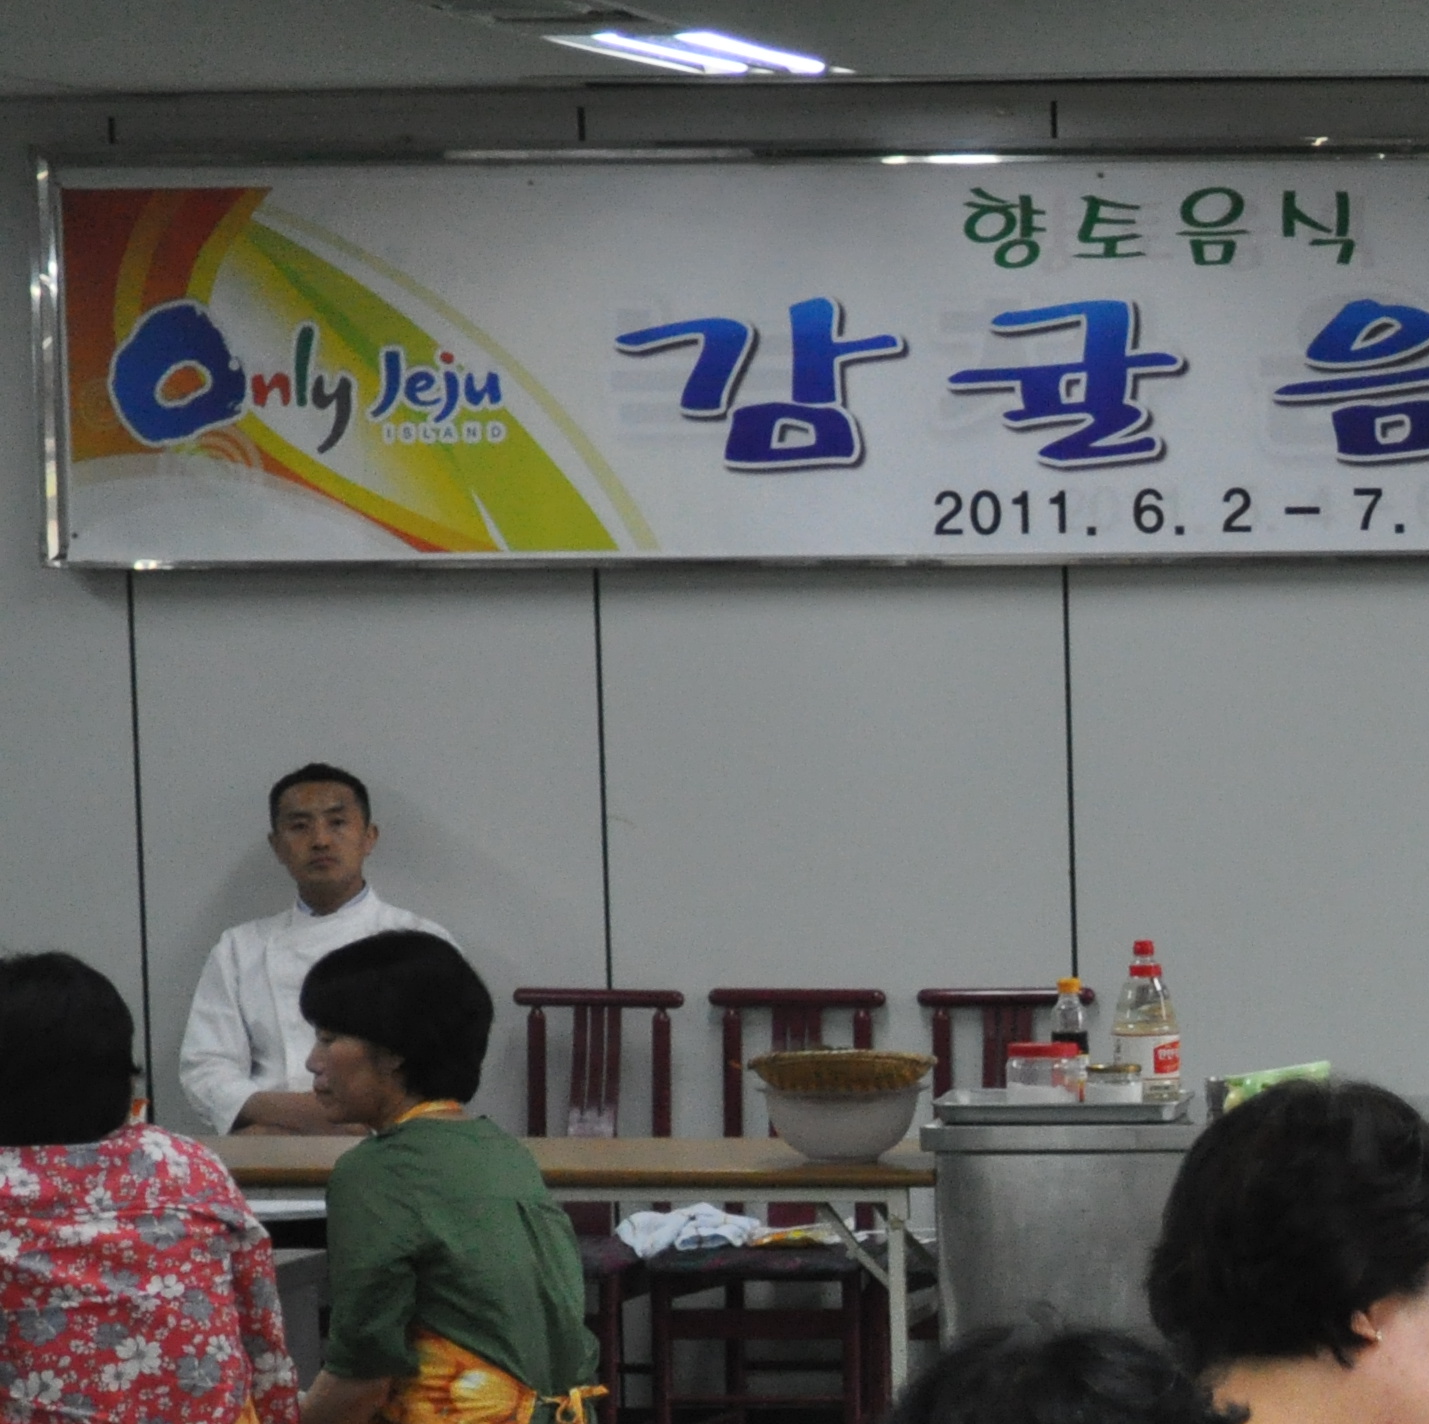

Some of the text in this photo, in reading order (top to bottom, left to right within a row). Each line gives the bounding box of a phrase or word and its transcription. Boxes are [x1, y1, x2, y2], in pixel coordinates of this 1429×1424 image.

[964, 186, 1355, 268] 향토음식
[111, 300, 504, 453] Only Jeju
[383, 422, 506, 444] ISLAND
[934, 488, 1097, 536] 2011.
